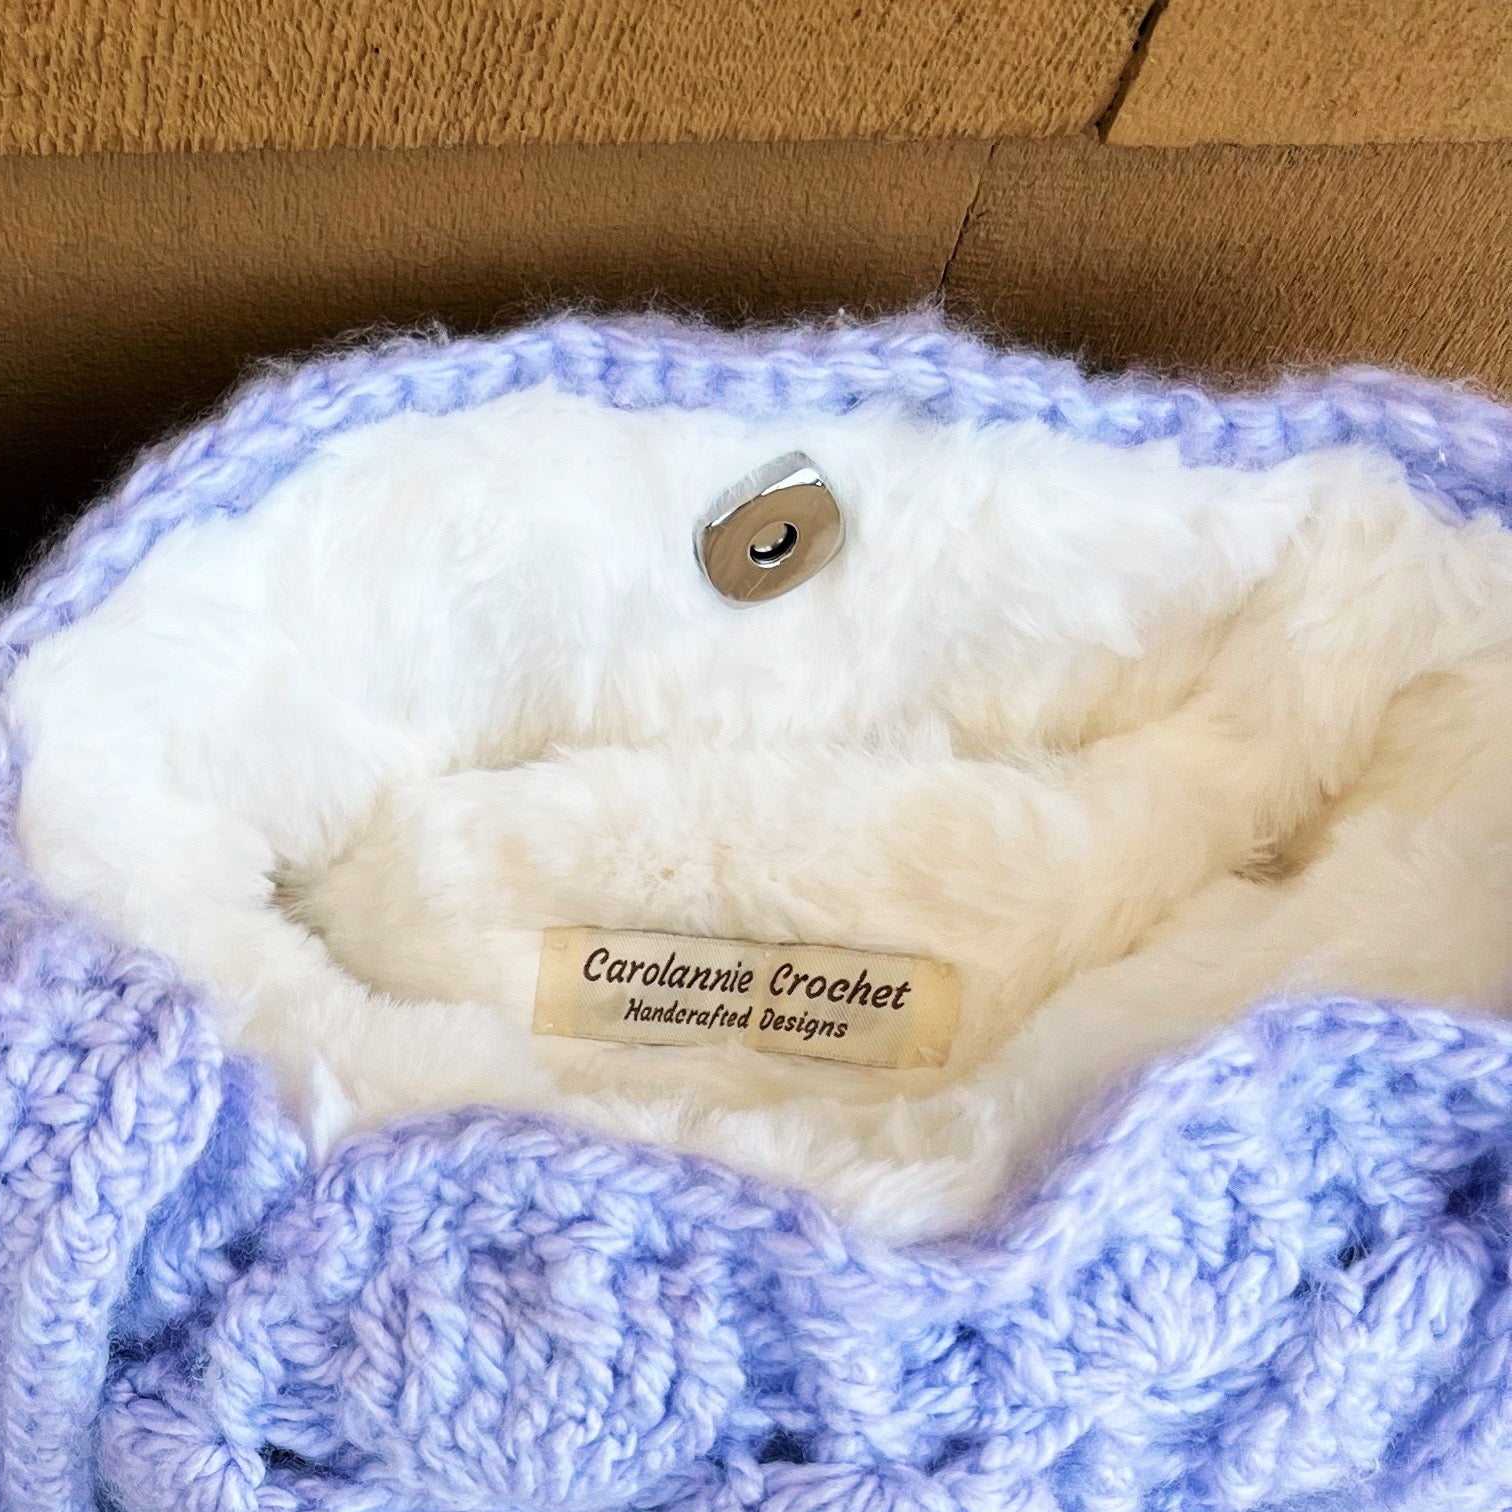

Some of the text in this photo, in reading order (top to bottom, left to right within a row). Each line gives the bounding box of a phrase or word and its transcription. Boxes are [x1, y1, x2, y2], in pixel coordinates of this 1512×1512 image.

[583, 947, 912, 1010] Carolannie Crochet
[624, 998, 849, 1041] Handcrafted Designs
